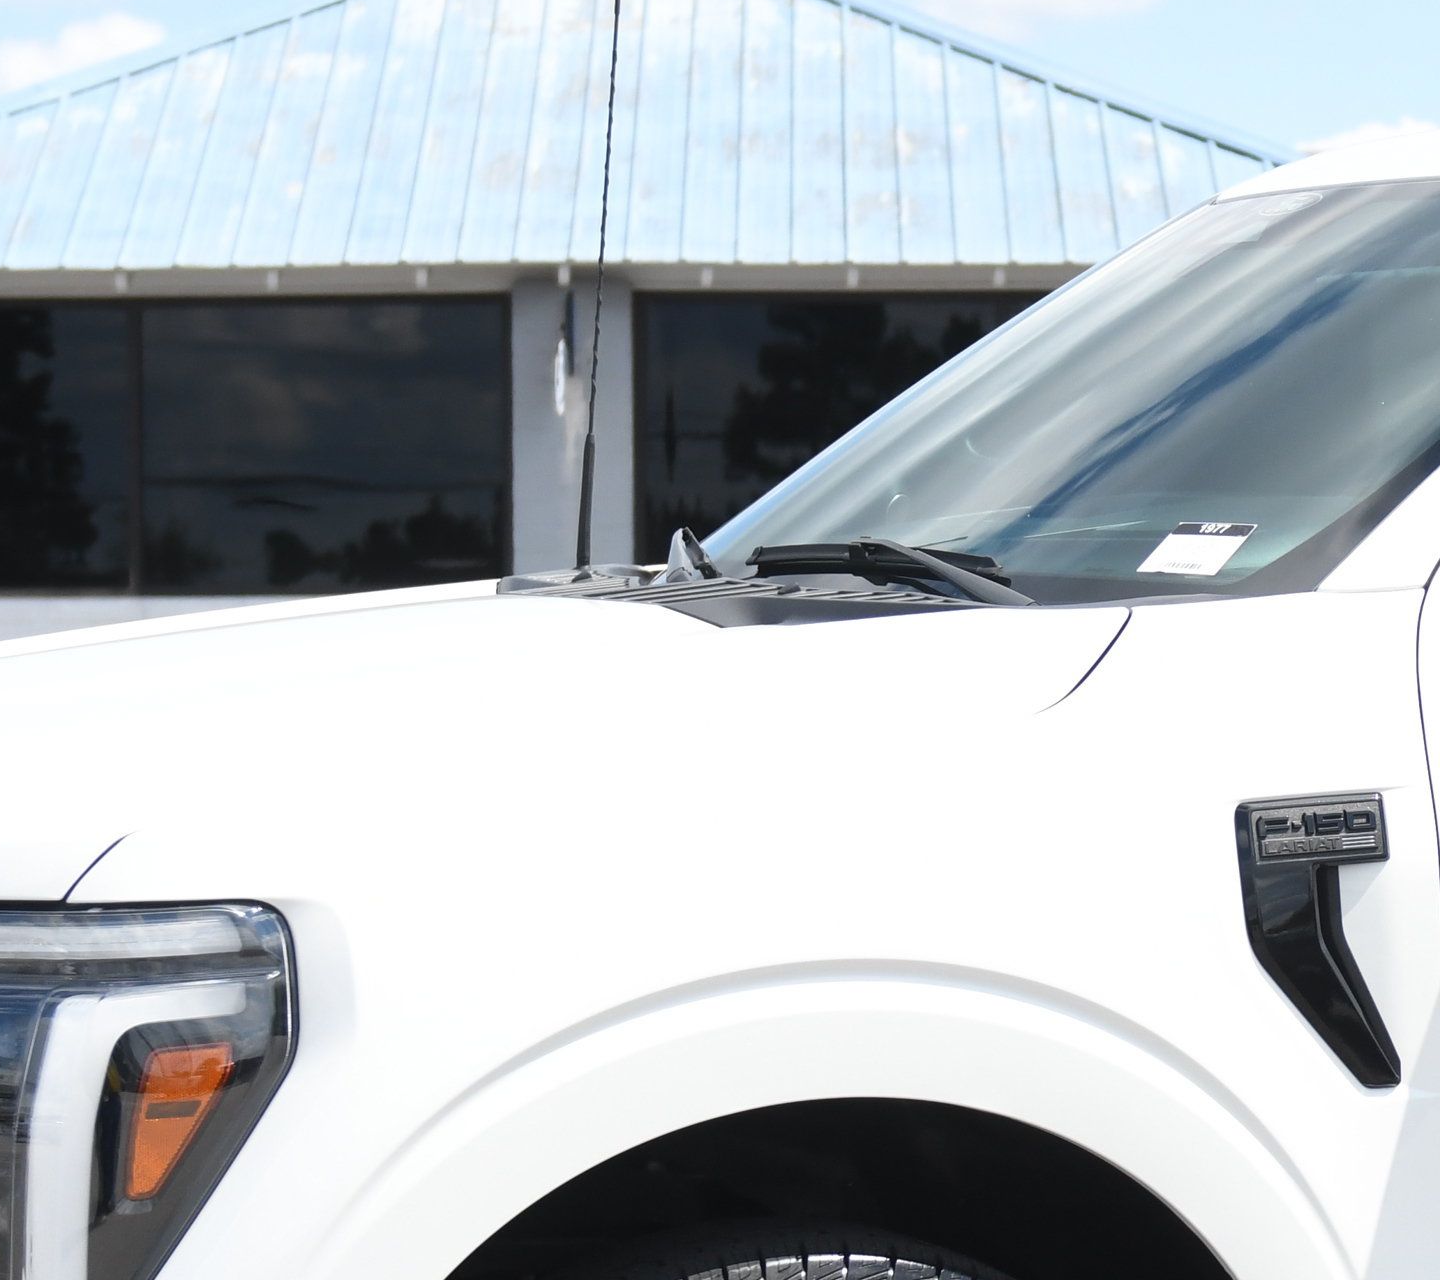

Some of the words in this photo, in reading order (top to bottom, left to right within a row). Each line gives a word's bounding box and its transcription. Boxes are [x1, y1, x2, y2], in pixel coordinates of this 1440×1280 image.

[1199, 523, 1232, 534] 1977
[1256, 810, 1377, 840] F-150
[1263, 837, 1340, 855] LARIAT
